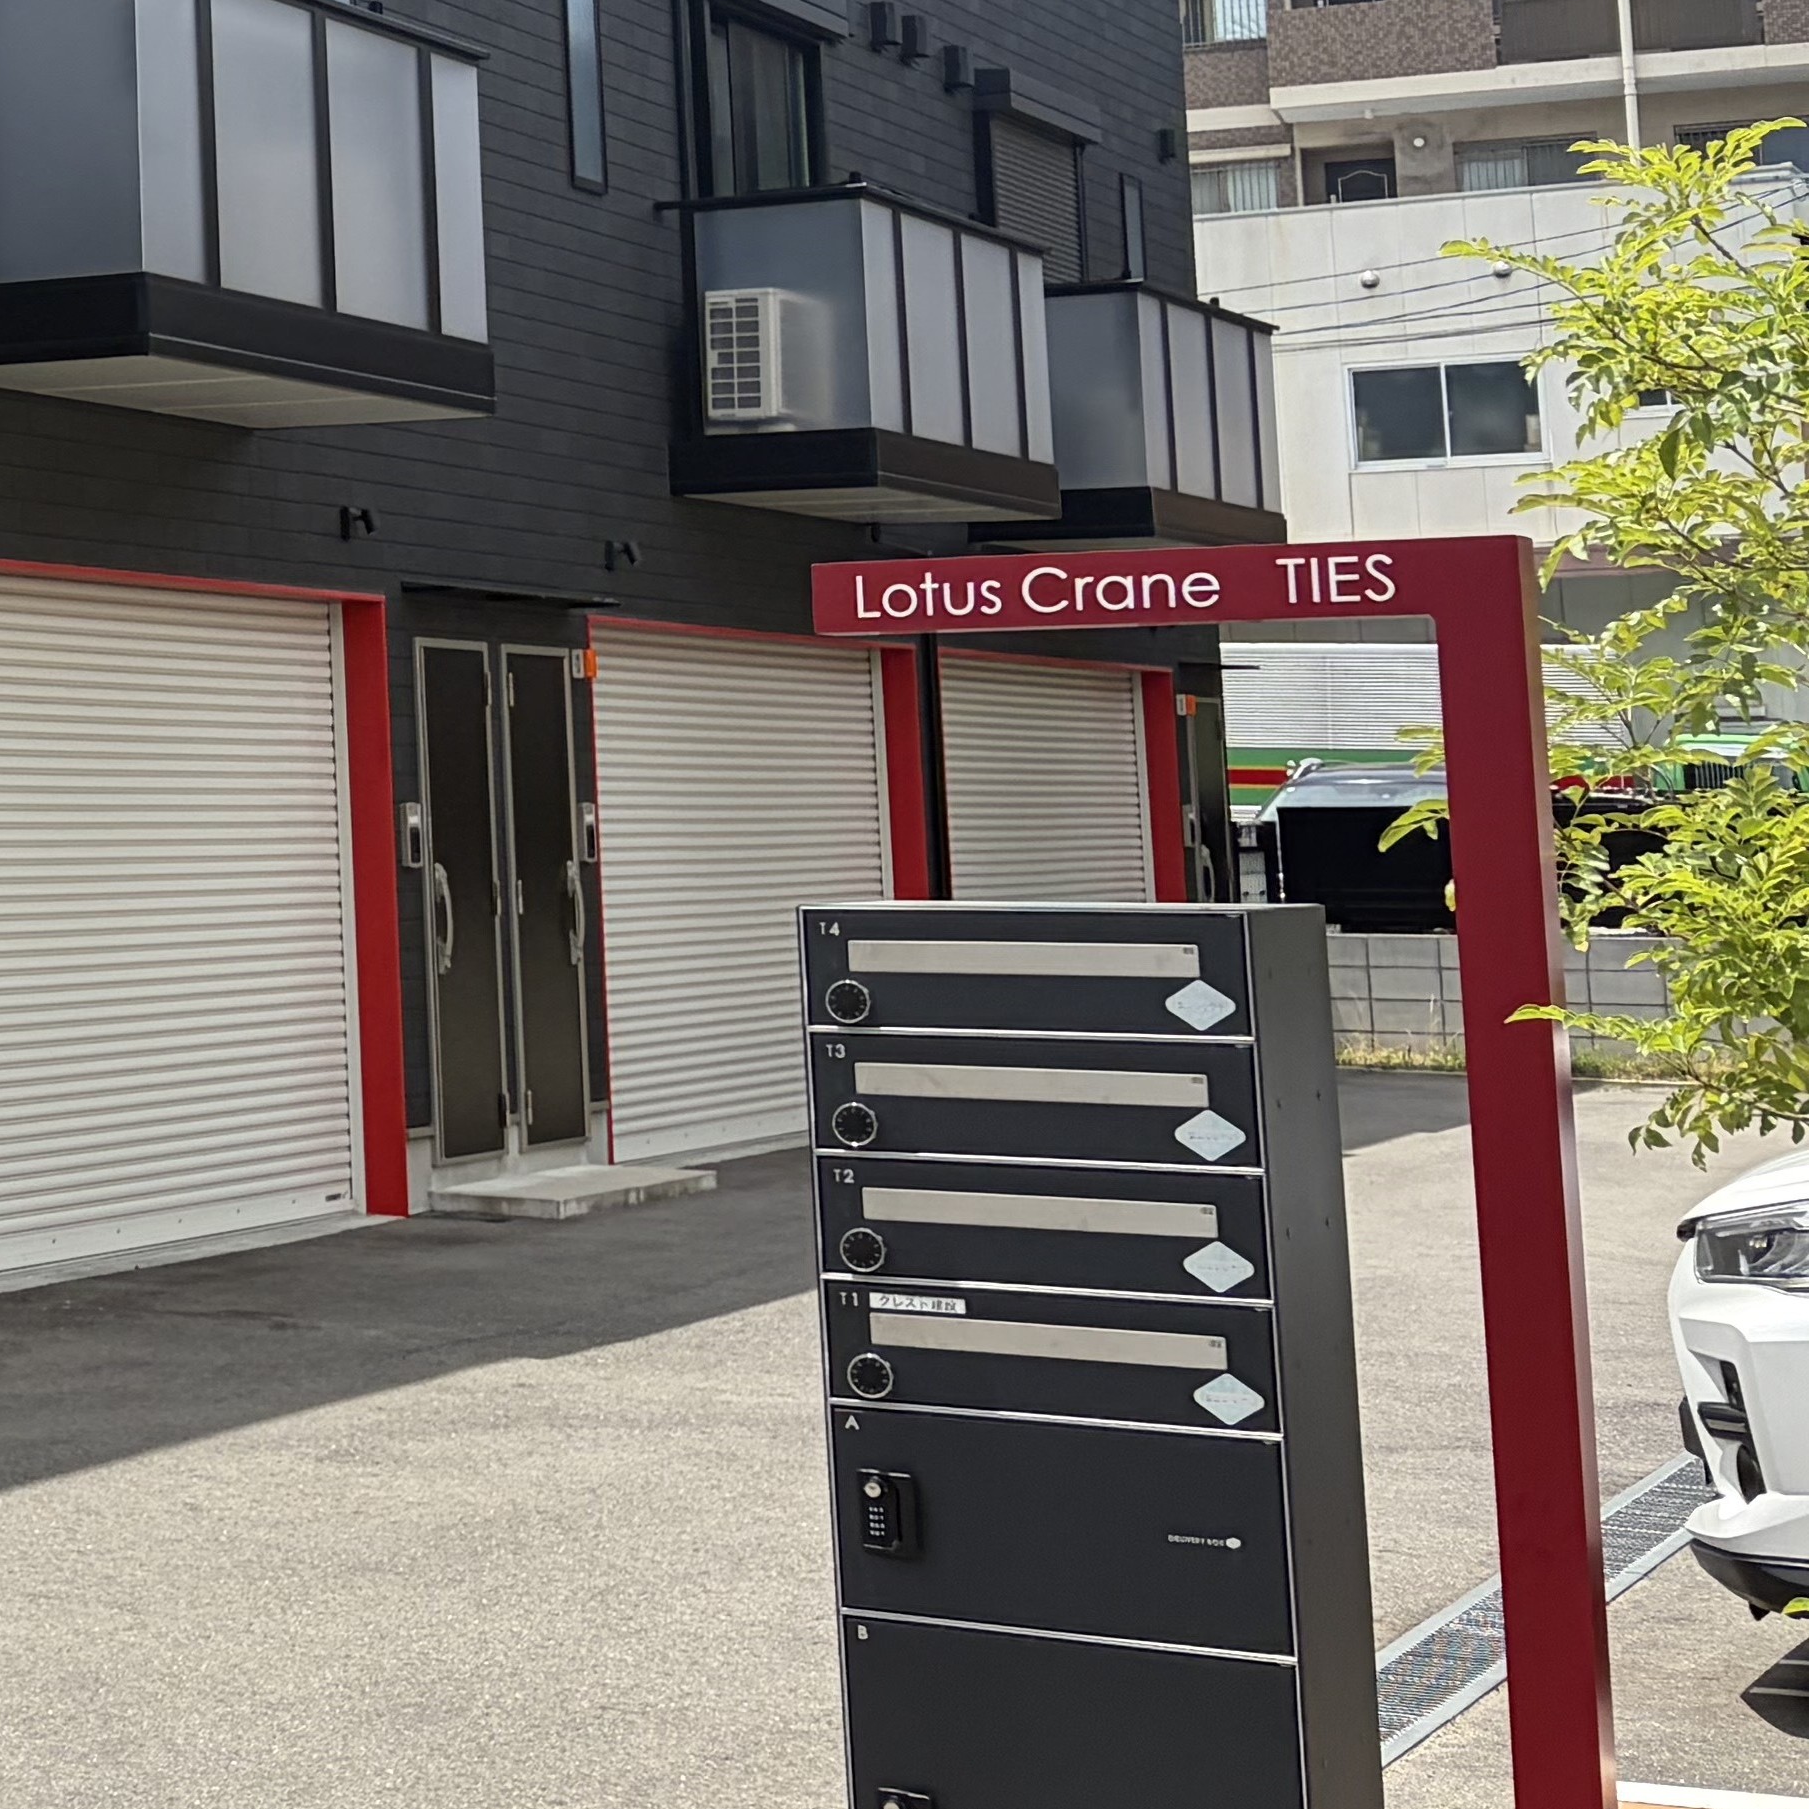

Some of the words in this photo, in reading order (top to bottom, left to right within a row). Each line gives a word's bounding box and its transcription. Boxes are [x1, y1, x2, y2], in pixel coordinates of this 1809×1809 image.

[855, 571, 1003, 620] Lotus
[1020, 565, 1221, 614] Crane
[1274, 552, 1397, 605] TIES
[819, 921, 840, 936] T4
[825, 1043, 846, 1059] T3
[833, 1168, 855, 1184] T2
[840, 1292, 859, 1307] T1
[844, 1414, 860, 1430] A
[857, 1624, 869, 1640] B
